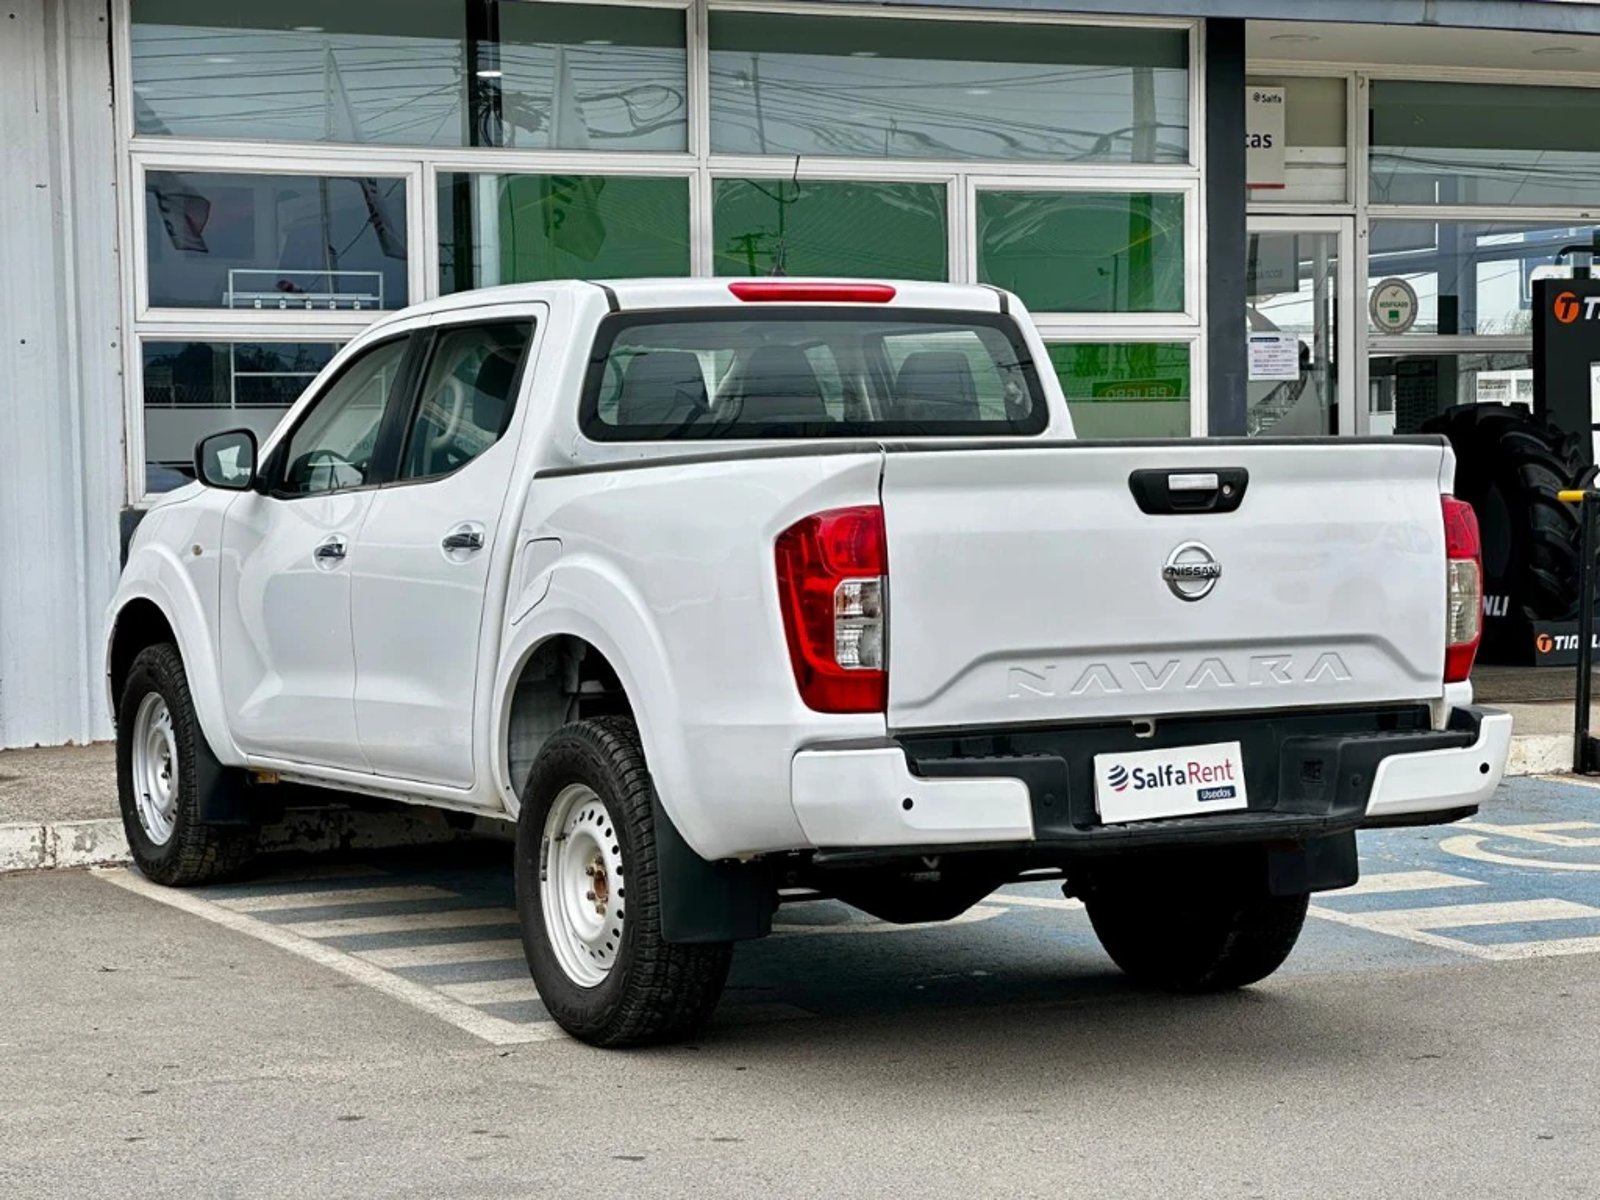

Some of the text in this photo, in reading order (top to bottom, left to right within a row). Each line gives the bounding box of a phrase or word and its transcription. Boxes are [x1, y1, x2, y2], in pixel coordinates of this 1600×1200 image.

[1584, 296, 1600, 320] T
[1171, 565, 1217, 577] NISSAN
[1008, 652, 1351, 698] NAVARA
